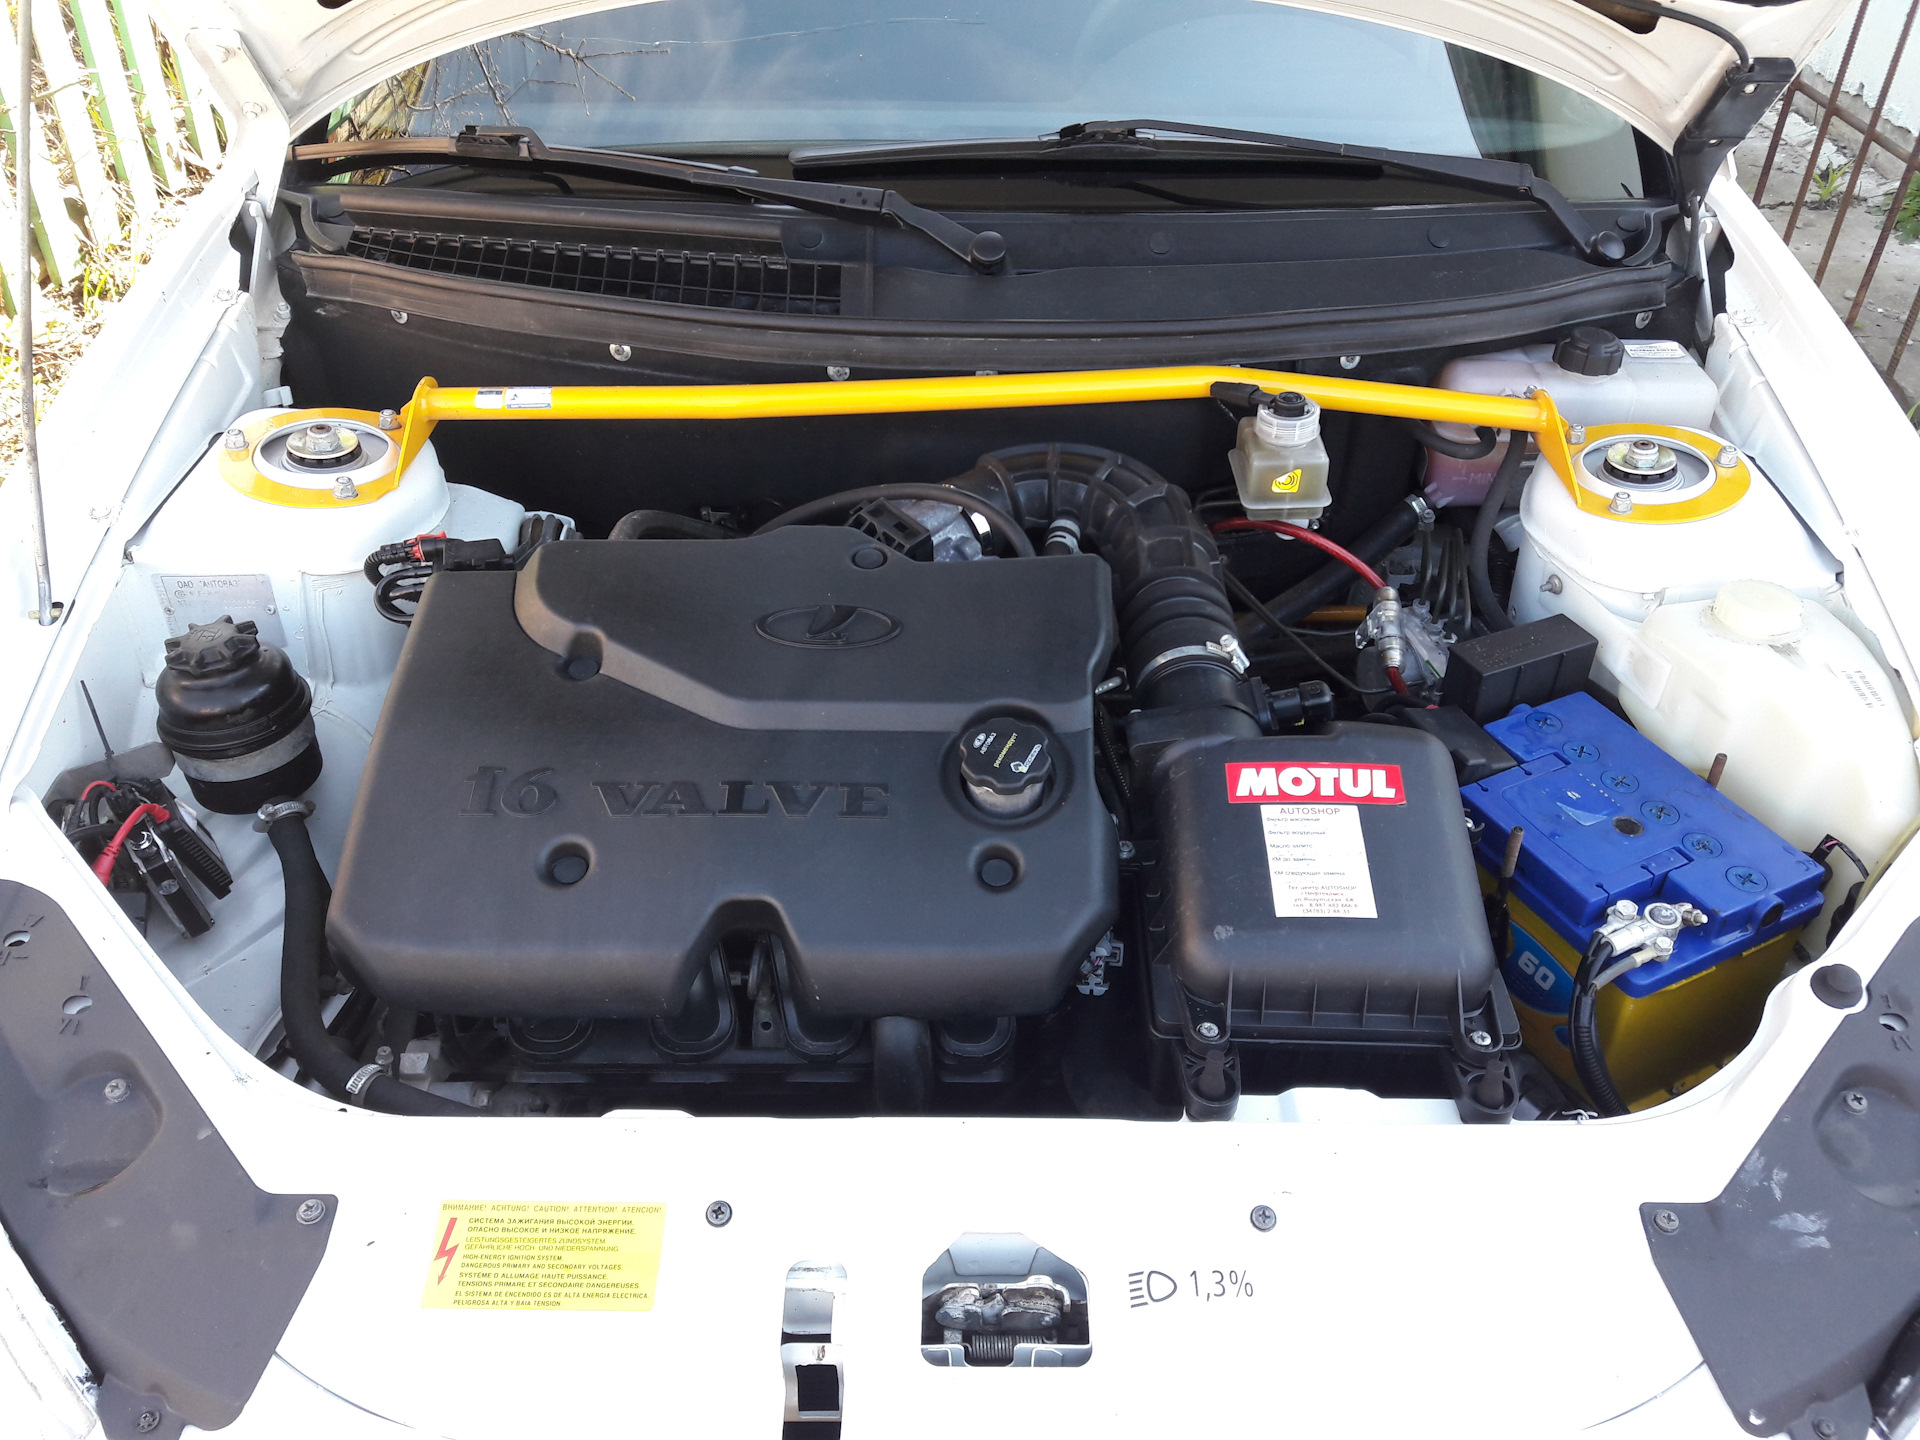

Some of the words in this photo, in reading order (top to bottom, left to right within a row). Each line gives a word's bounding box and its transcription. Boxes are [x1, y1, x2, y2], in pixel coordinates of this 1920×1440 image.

[459, 766, 557, 818] 16
[590, 779, 890, 819] VALVE
[1236, 767, 1396, 799] MOTUL
[1279, 807, 1341, 815] AUTOSHOP
[1518, 951, 1556, 991] 60
[491, 1204, 530, 1212] ACHTUNG!
[1189, 1269, 1254, 1302] 1,3%
